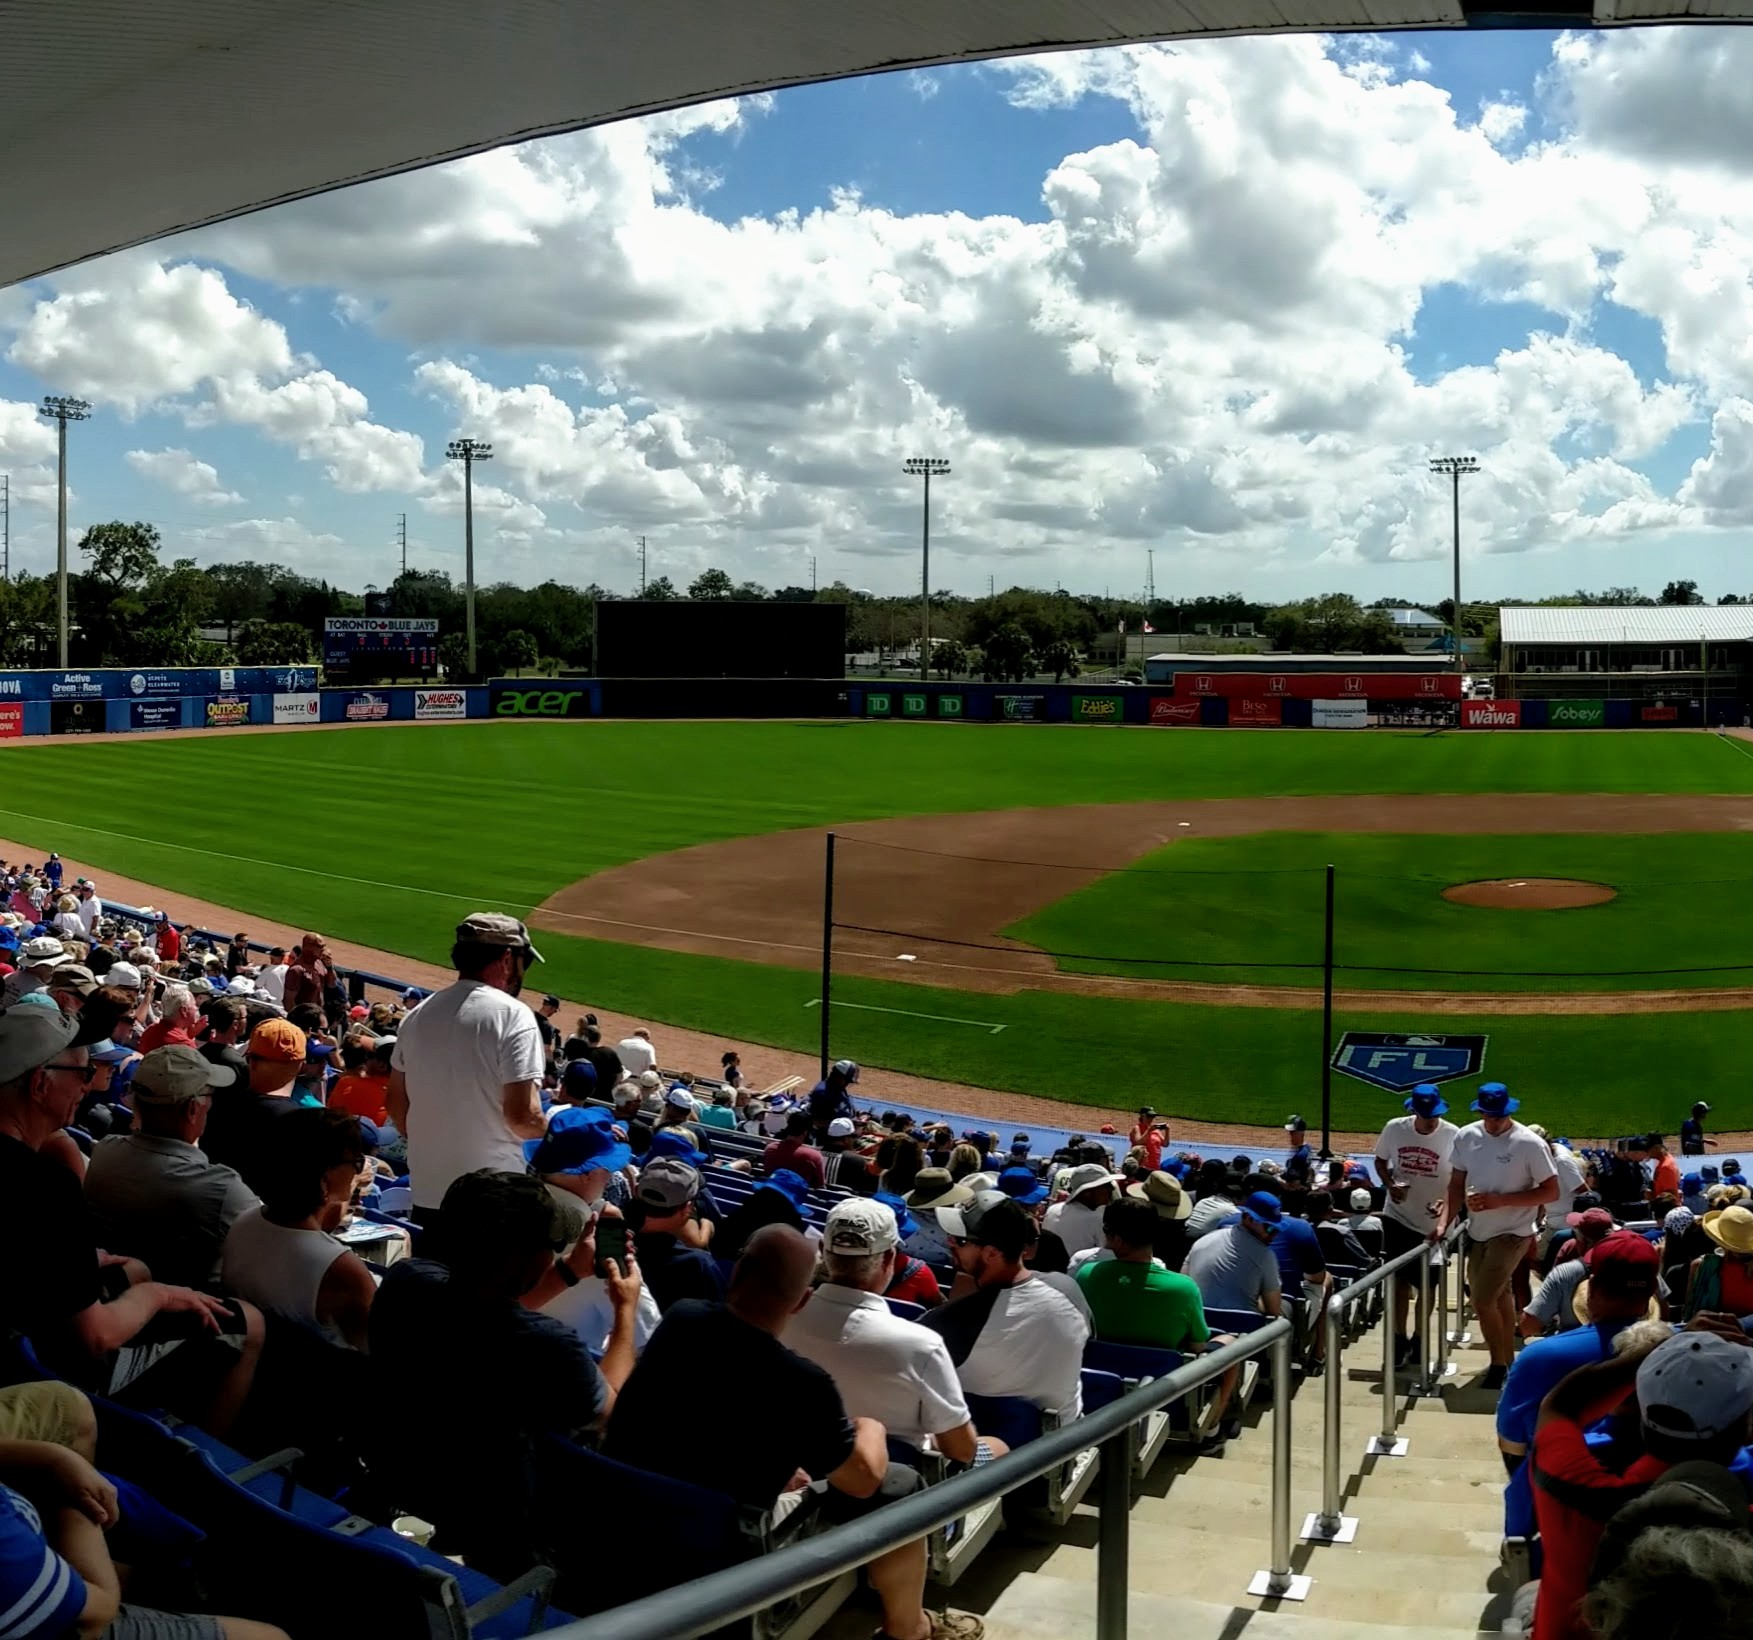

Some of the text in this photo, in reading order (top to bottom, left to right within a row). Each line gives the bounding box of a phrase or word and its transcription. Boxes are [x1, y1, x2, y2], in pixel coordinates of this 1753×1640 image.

[328, 620, 436, 630] TORONTO BLUE JAYS
[64, 674, 90, 682] Active
[52, 684, 76, 692] Green
[82, 683, 102, 692] Ross
[428, 693, 458, 704] HUGHES
[496, 691, 583, 714] acer
[868, 698, 889, 711] TD
[905, 698, 925, 712] TD
[941, 698, 961, 712] TD
[207, 702, 249, 716] OUTPOST
[1080, 700, 1116, 714] Eddie's
[1158, 704, 1195, 714] Budweiser
[1552, 706, 1601, 720] Sobeys
[1468, 710, 1516, 724] Wawa
[1368, 1052, 1448, 1070] FL
